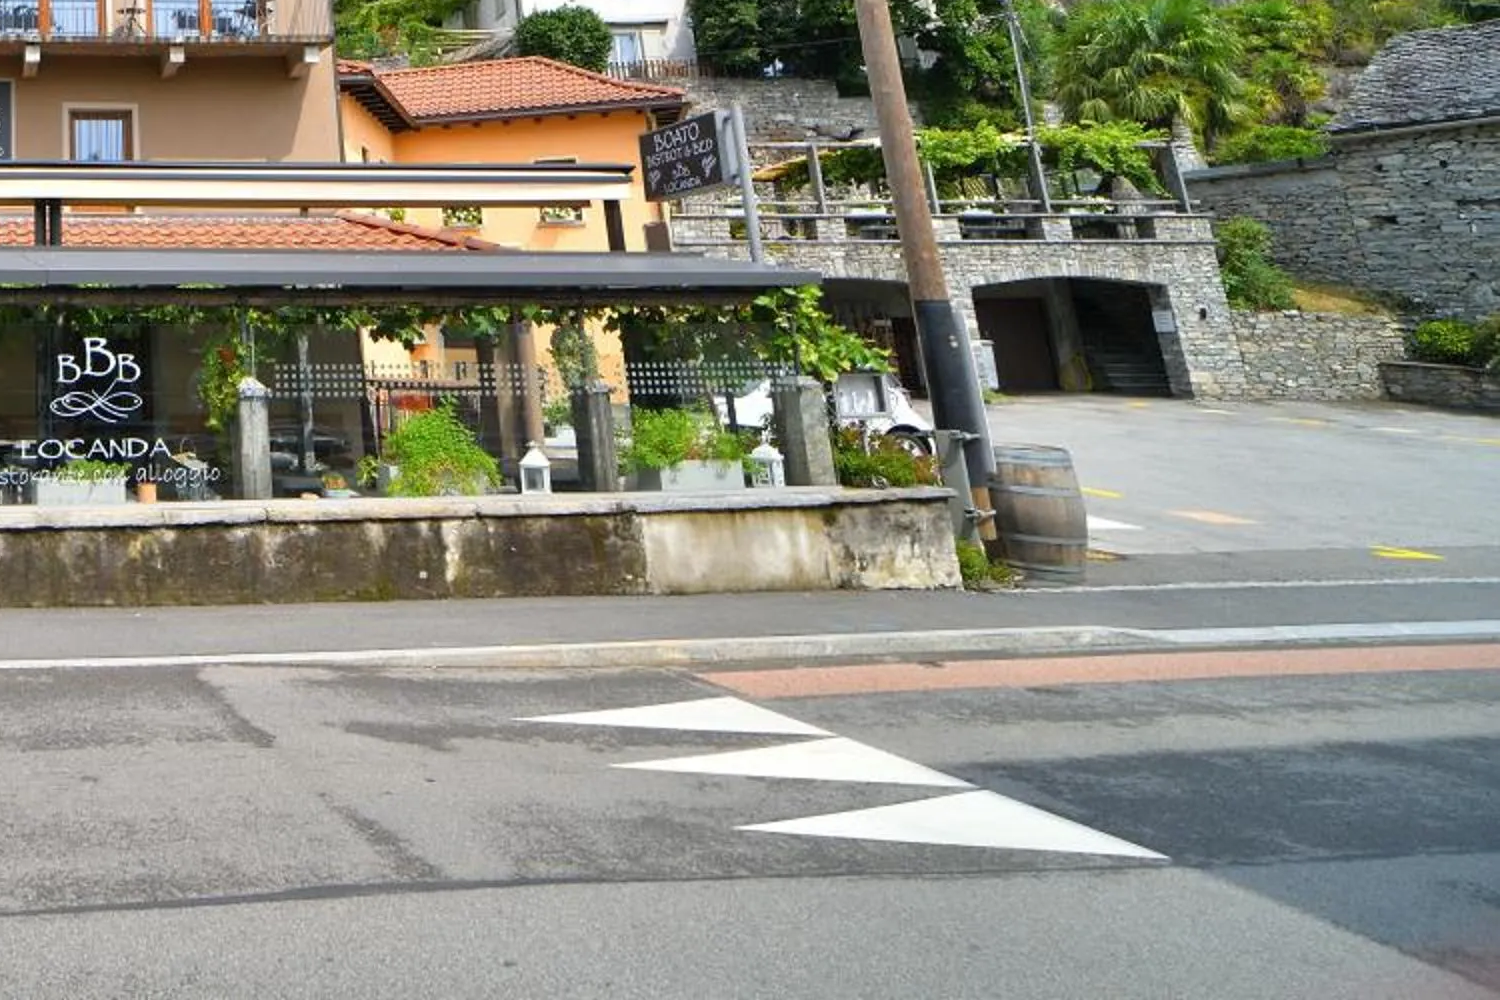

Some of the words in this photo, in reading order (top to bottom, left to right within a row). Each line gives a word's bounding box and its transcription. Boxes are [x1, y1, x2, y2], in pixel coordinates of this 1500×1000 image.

[653, 121, 700, 153] BOATO
[57, 336, 142, 383] BBB
[21, 437, 172, 460] LOCANDA
[135, 463, 221, 489] alloggio
